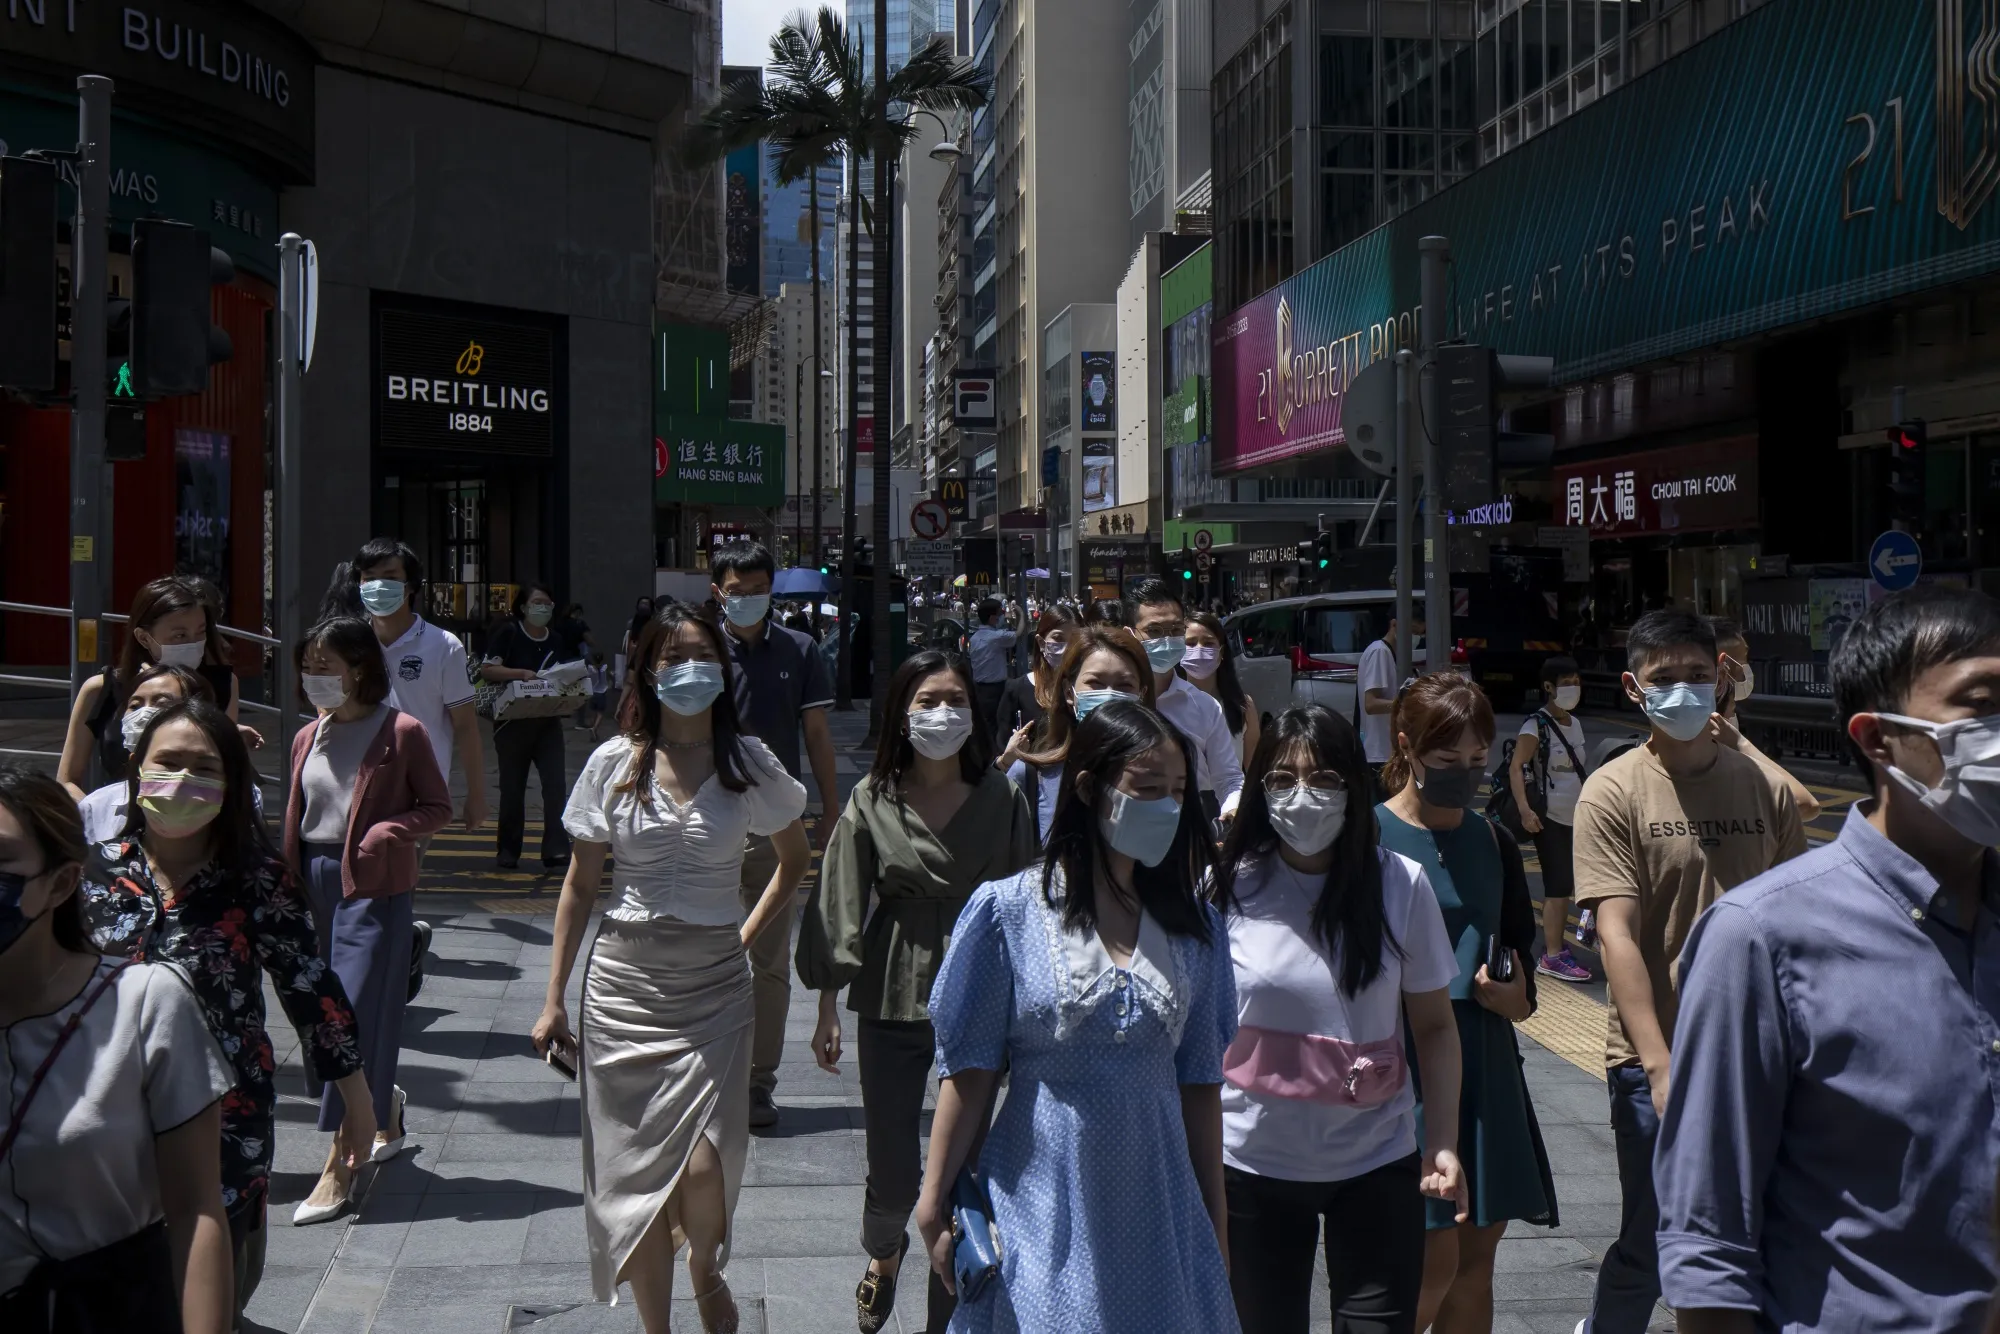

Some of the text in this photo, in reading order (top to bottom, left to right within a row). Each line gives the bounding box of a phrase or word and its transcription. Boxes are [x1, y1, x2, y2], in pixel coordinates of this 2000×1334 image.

[123, 7, 290, 108] BUILDING
[1844, 96, 1903, 220] 21
[1457, 179, 1770, 337] LIFE AT ITS PEAK
[388, 375, 549, 412] BREITLING
[1258, 368, 1273, 422] 21
[449, 412, 493, 433] 1884
[677, 437, 764, 467] 恒生銀行
[678, 468, 764, 485] HANG SENG BANK
[1651, 473, 1737, 500] CHOW TAI FOOK
[1566, 470, 1636, 526] 周大福
[931, 542, 942, 550] 10
[1249, 546, 1298, 564] AMERICAN EAGLE
